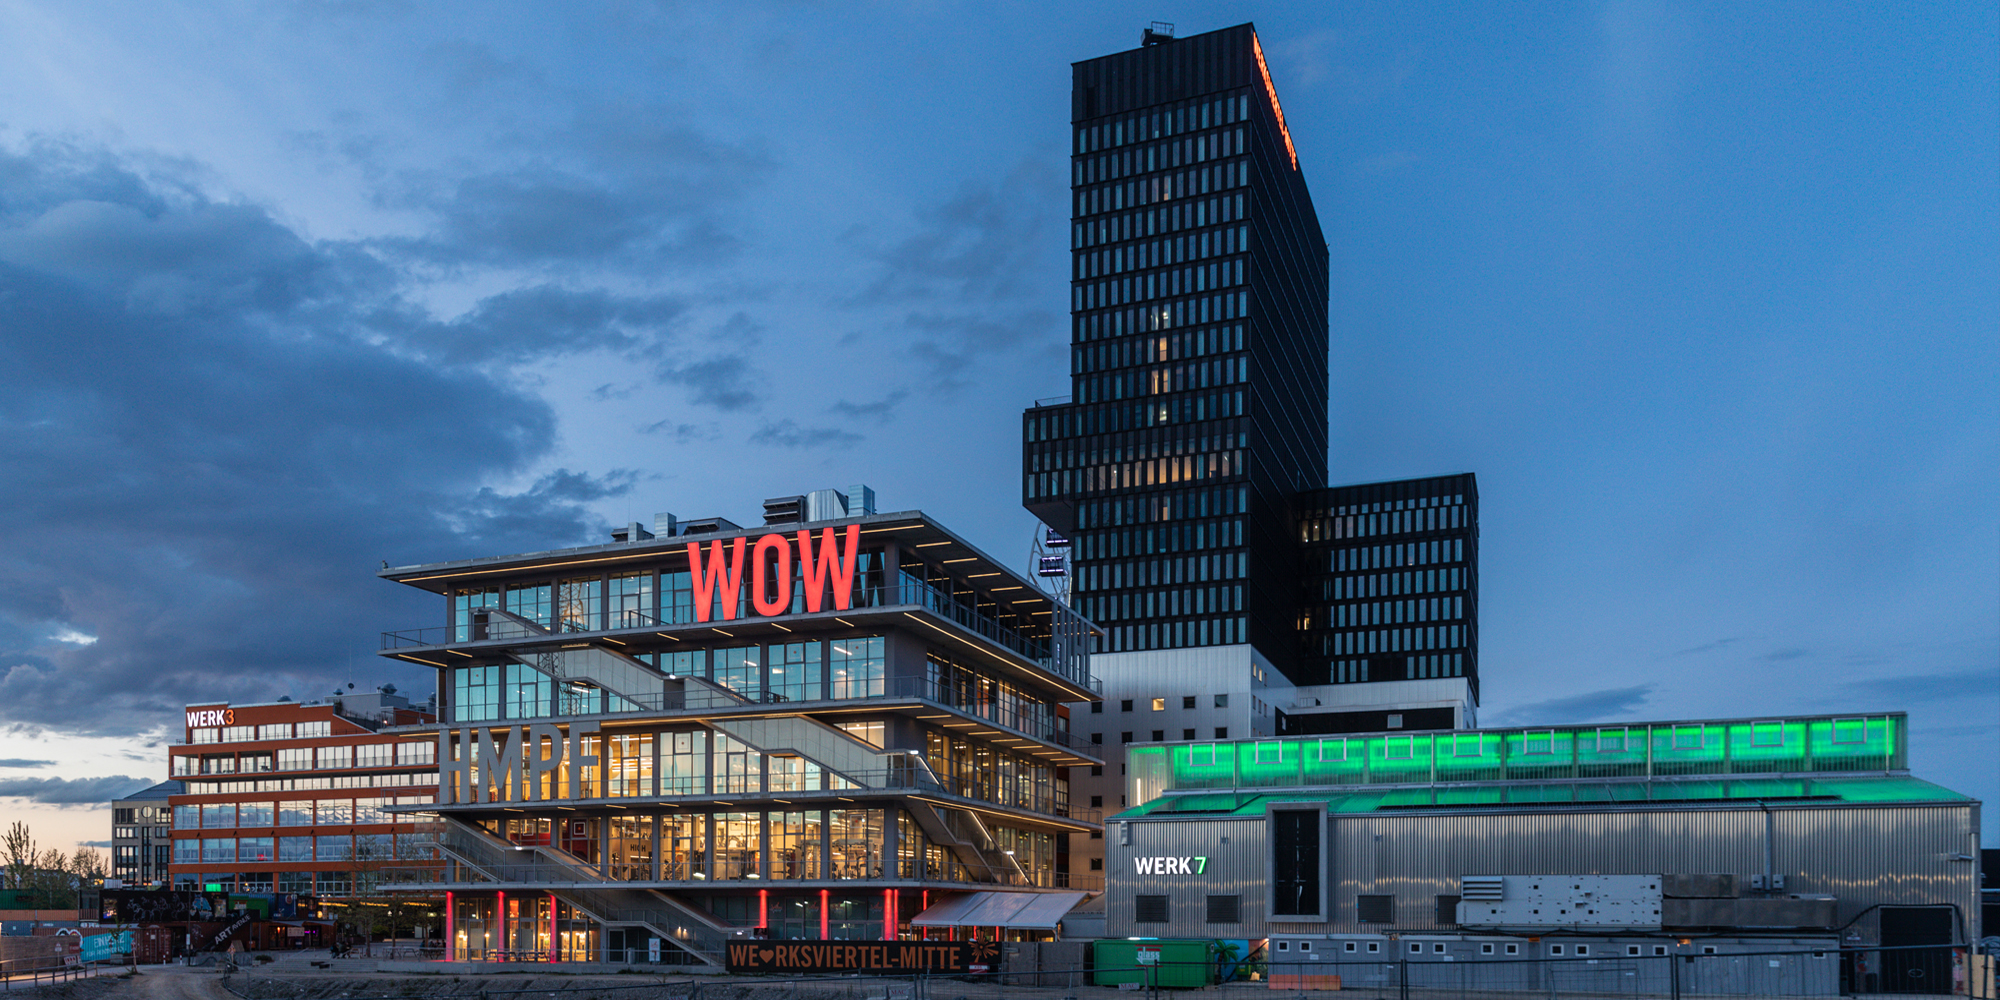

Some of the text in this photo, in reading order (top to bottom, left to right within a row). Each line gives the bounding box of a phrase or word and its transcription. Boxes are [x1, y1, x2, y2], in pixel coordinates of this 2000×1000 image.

[687, 524, 860, 623] WOW
[439, 720, 601, 803] HMPF
[214, 913, 251, 945] ART AVENUE
